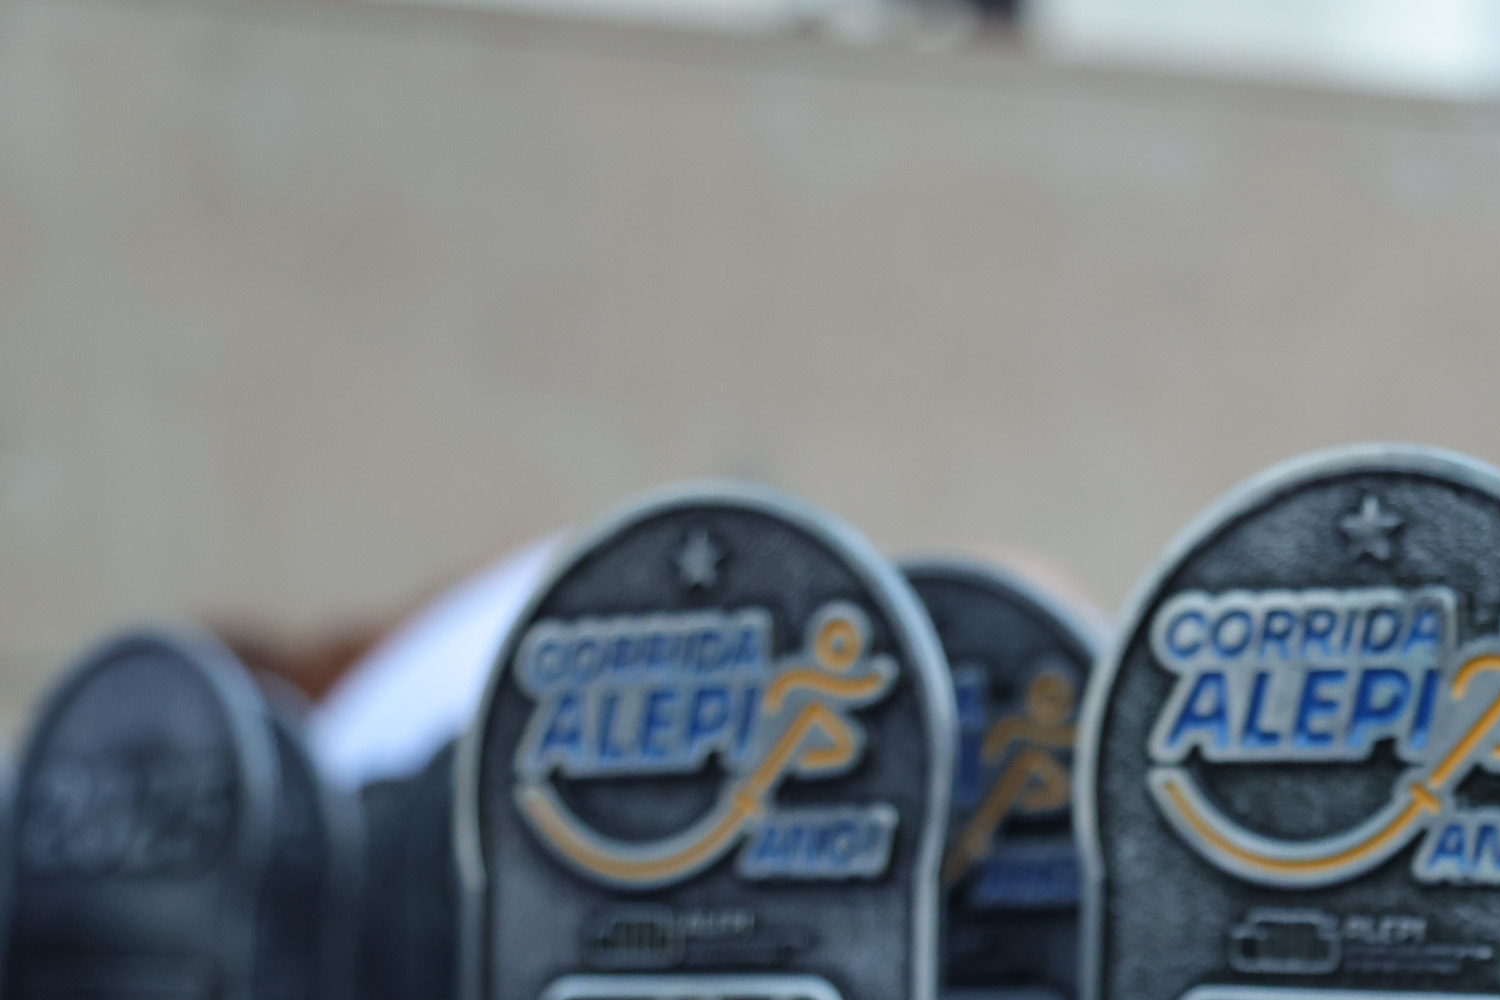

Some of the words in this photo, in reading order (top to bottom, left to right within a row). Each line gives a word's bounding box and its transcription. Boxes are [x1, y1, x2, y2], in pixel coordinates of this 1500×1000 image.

[1165, 608, 1440, 660] CORRIDA
[534, 685, 759, 765] ALEPI
[1165, 668, 1440, 750] ALEPI
